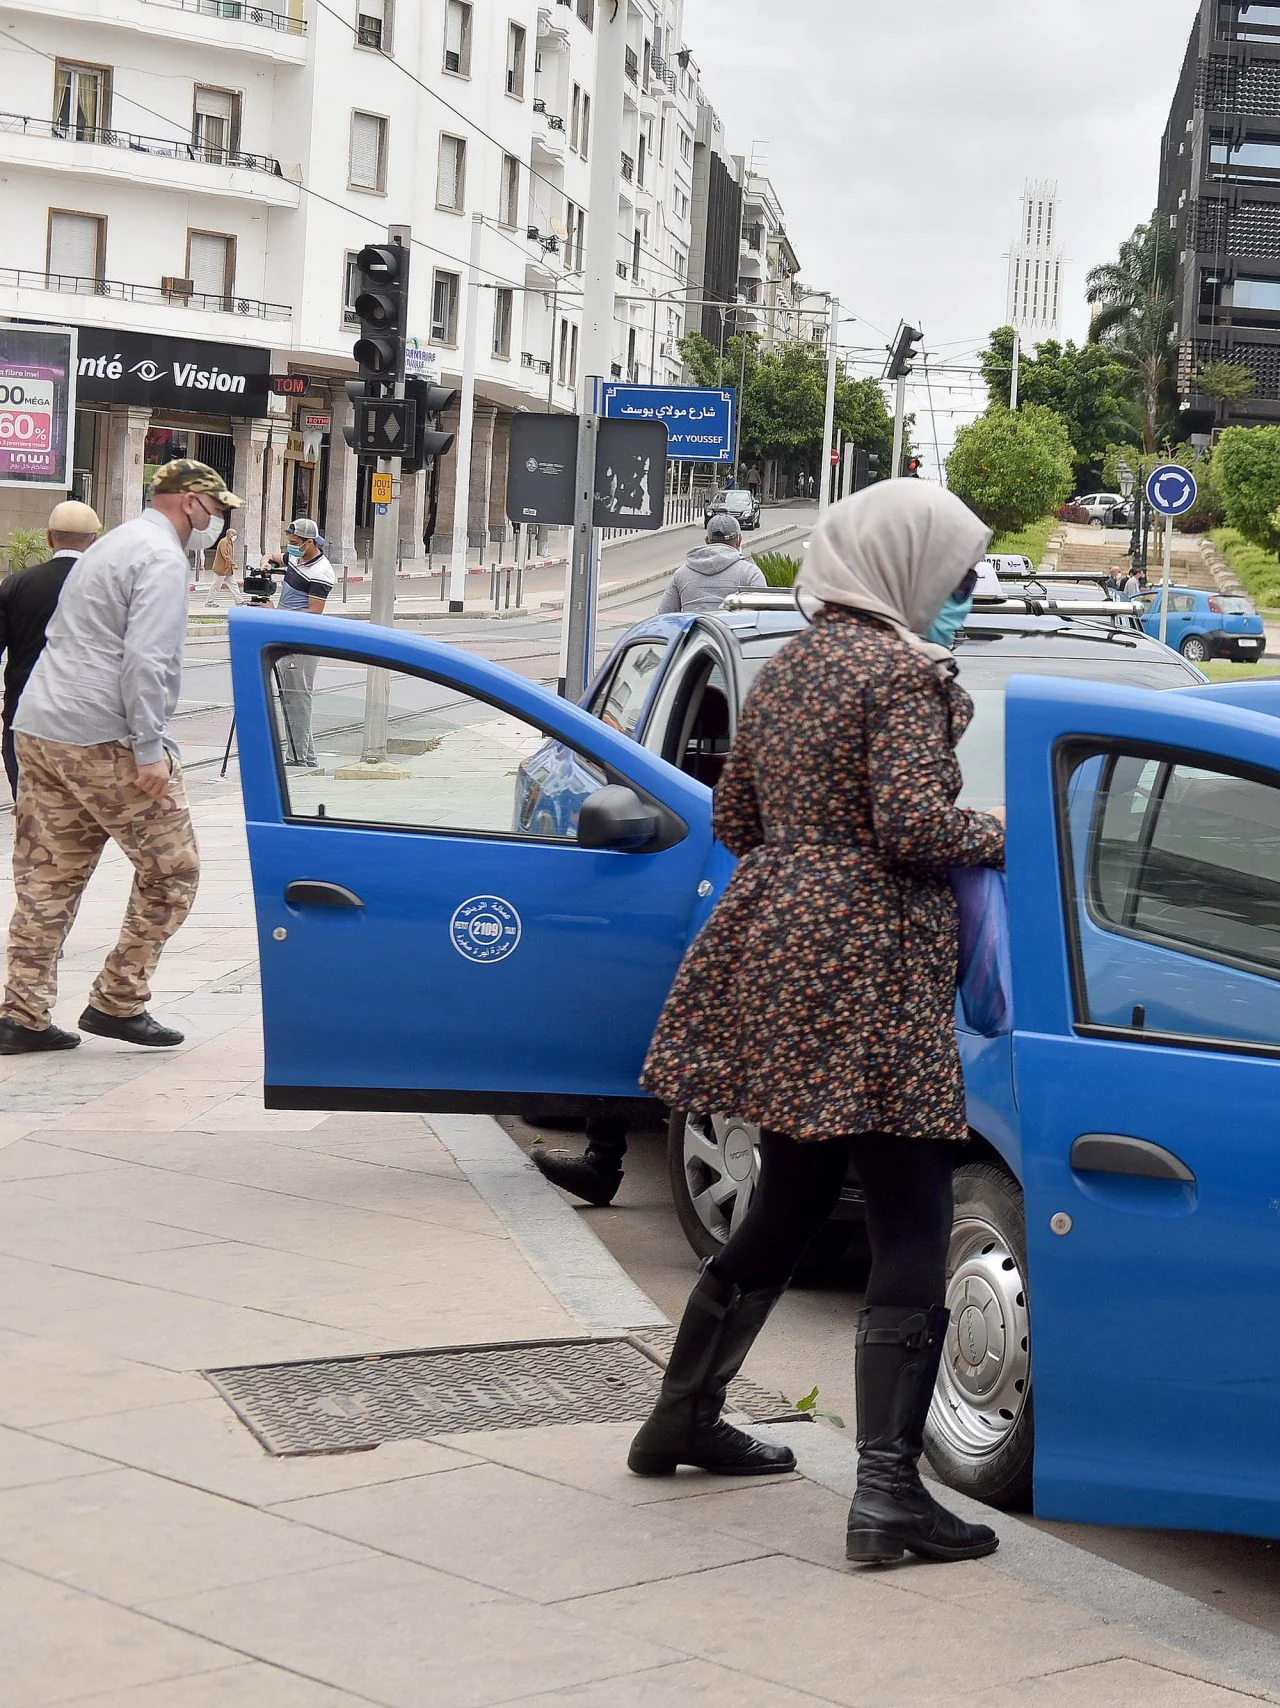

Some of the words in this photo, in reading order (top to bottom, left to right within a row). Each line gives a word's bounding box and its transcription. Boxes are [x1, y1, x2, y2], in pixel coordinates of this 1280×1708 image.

[5, 369, 23, 377] fibre
[24, 370, 40, 378] inwi
[77, 354, 122, 380] nté
[172, 362, 246, 394] Vision
[275, 378, 304, 393] TOM
[25, 396, 50, 406] MÉGA
[621, 404, 654, 418] يوسف
[655, 405, 686, 419] مولاي
[689, 406, 716, 420] شارع
[667, 434, 684, 442] LAY
[685, 434, 723, 444] YOUSSEF
[10, 453, 50, 464] inwi
[374, 480, 391, 489] JOU1
[377, 488, 386, 496] 03
[473, 921, 499, 937] 2109
